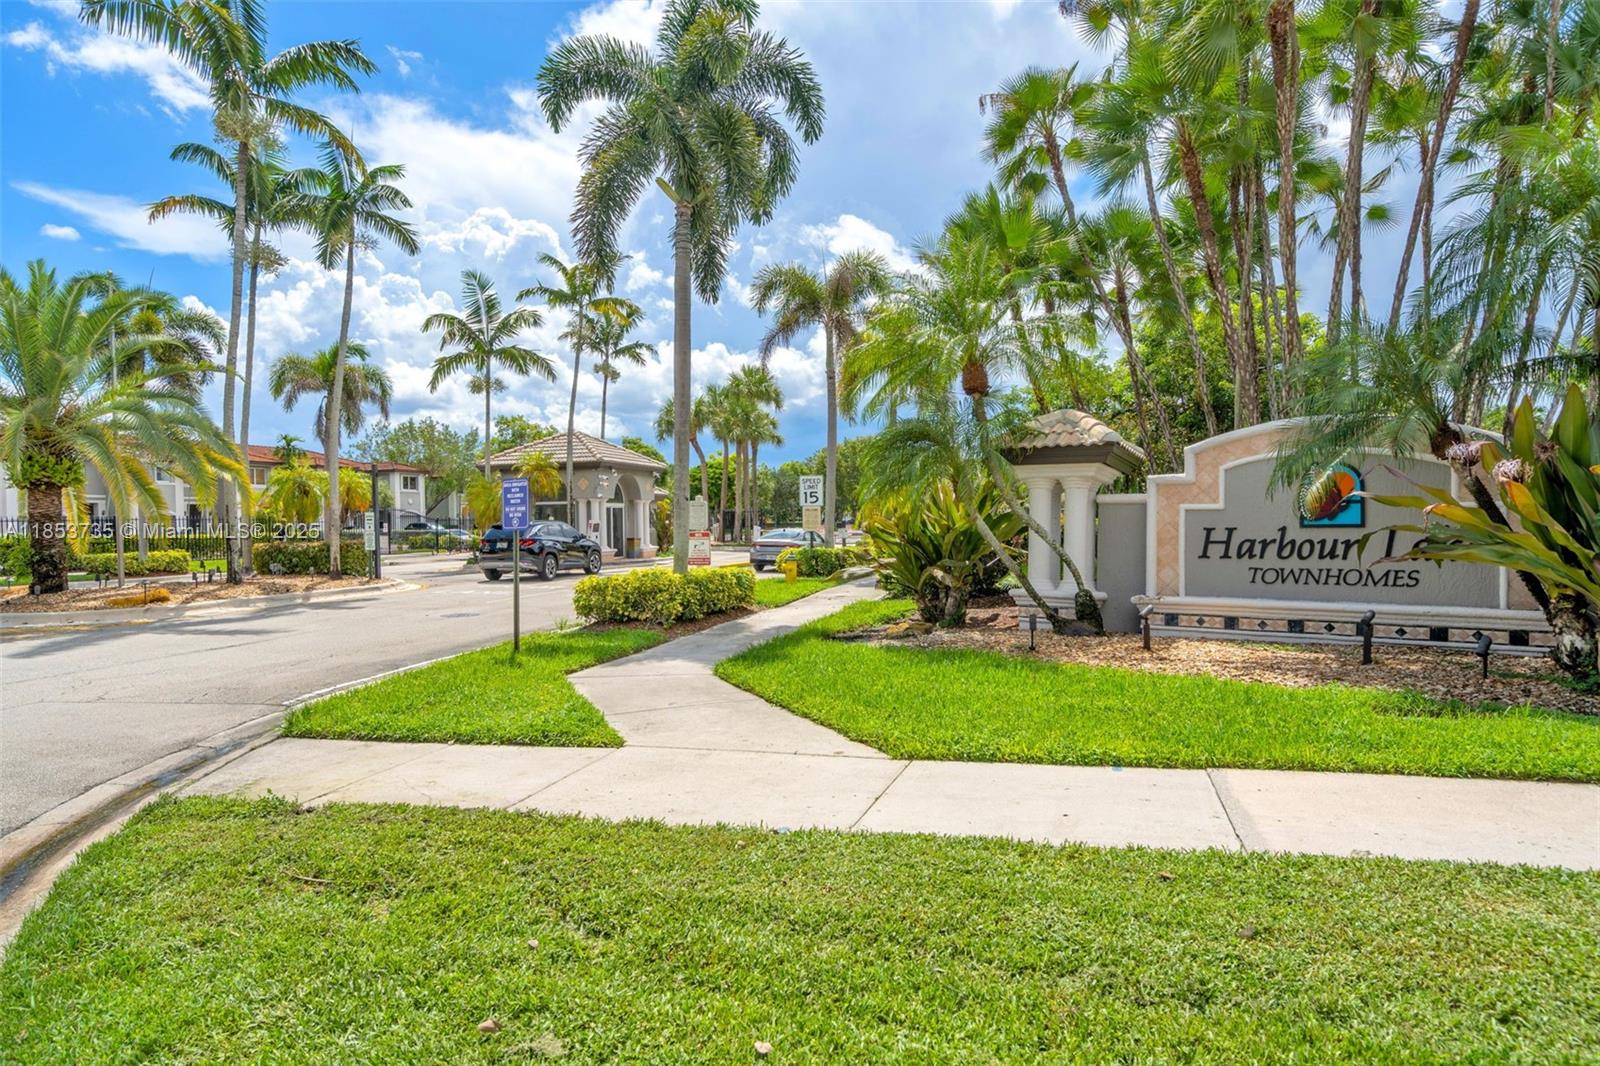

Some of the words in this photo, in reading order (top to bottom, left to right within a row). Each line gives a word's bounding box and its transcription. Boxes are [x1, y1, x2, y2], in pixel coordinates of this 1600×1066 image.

[804, 491, 819, 504] 15
[1198, 526, 1361, 560] Harbour
[1248, 566, 1420, 588] TOWNHOMES
